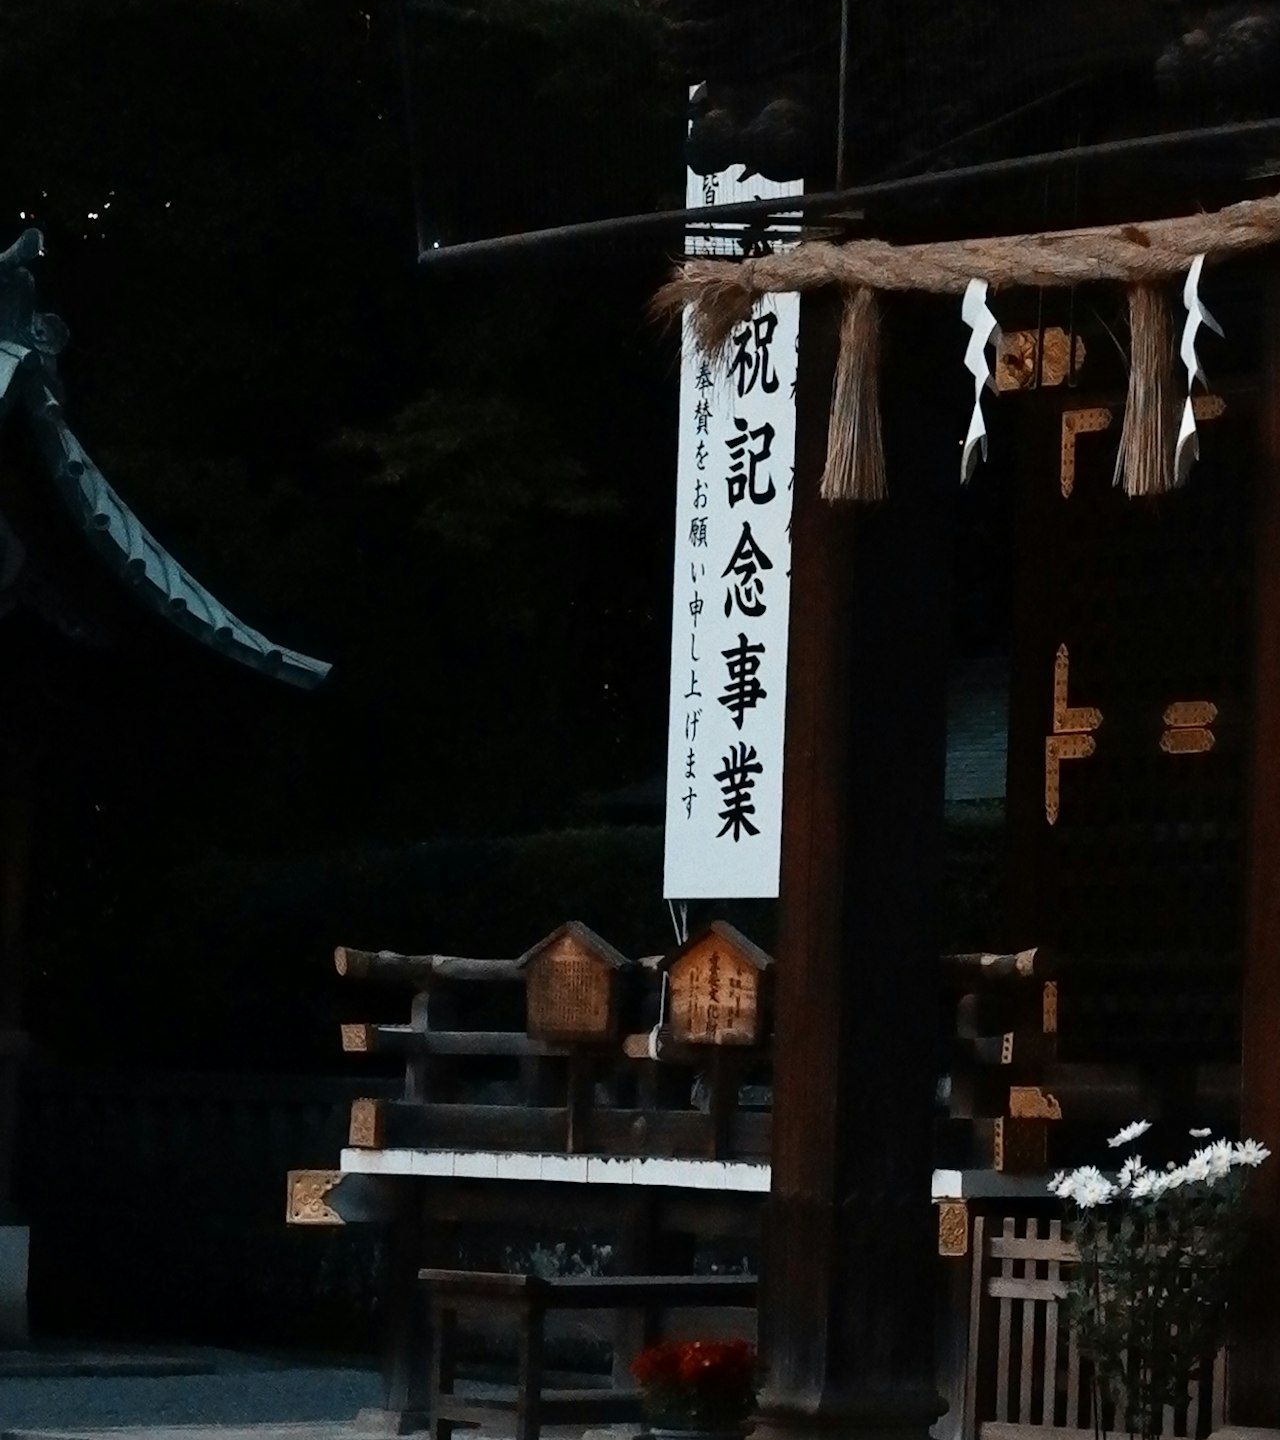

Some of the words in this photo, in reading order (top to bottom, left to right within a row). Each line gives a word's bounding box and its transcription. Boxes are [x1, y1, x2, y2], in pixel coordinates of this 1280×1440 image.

[714, 310, 780, 844] 祝記念事業
